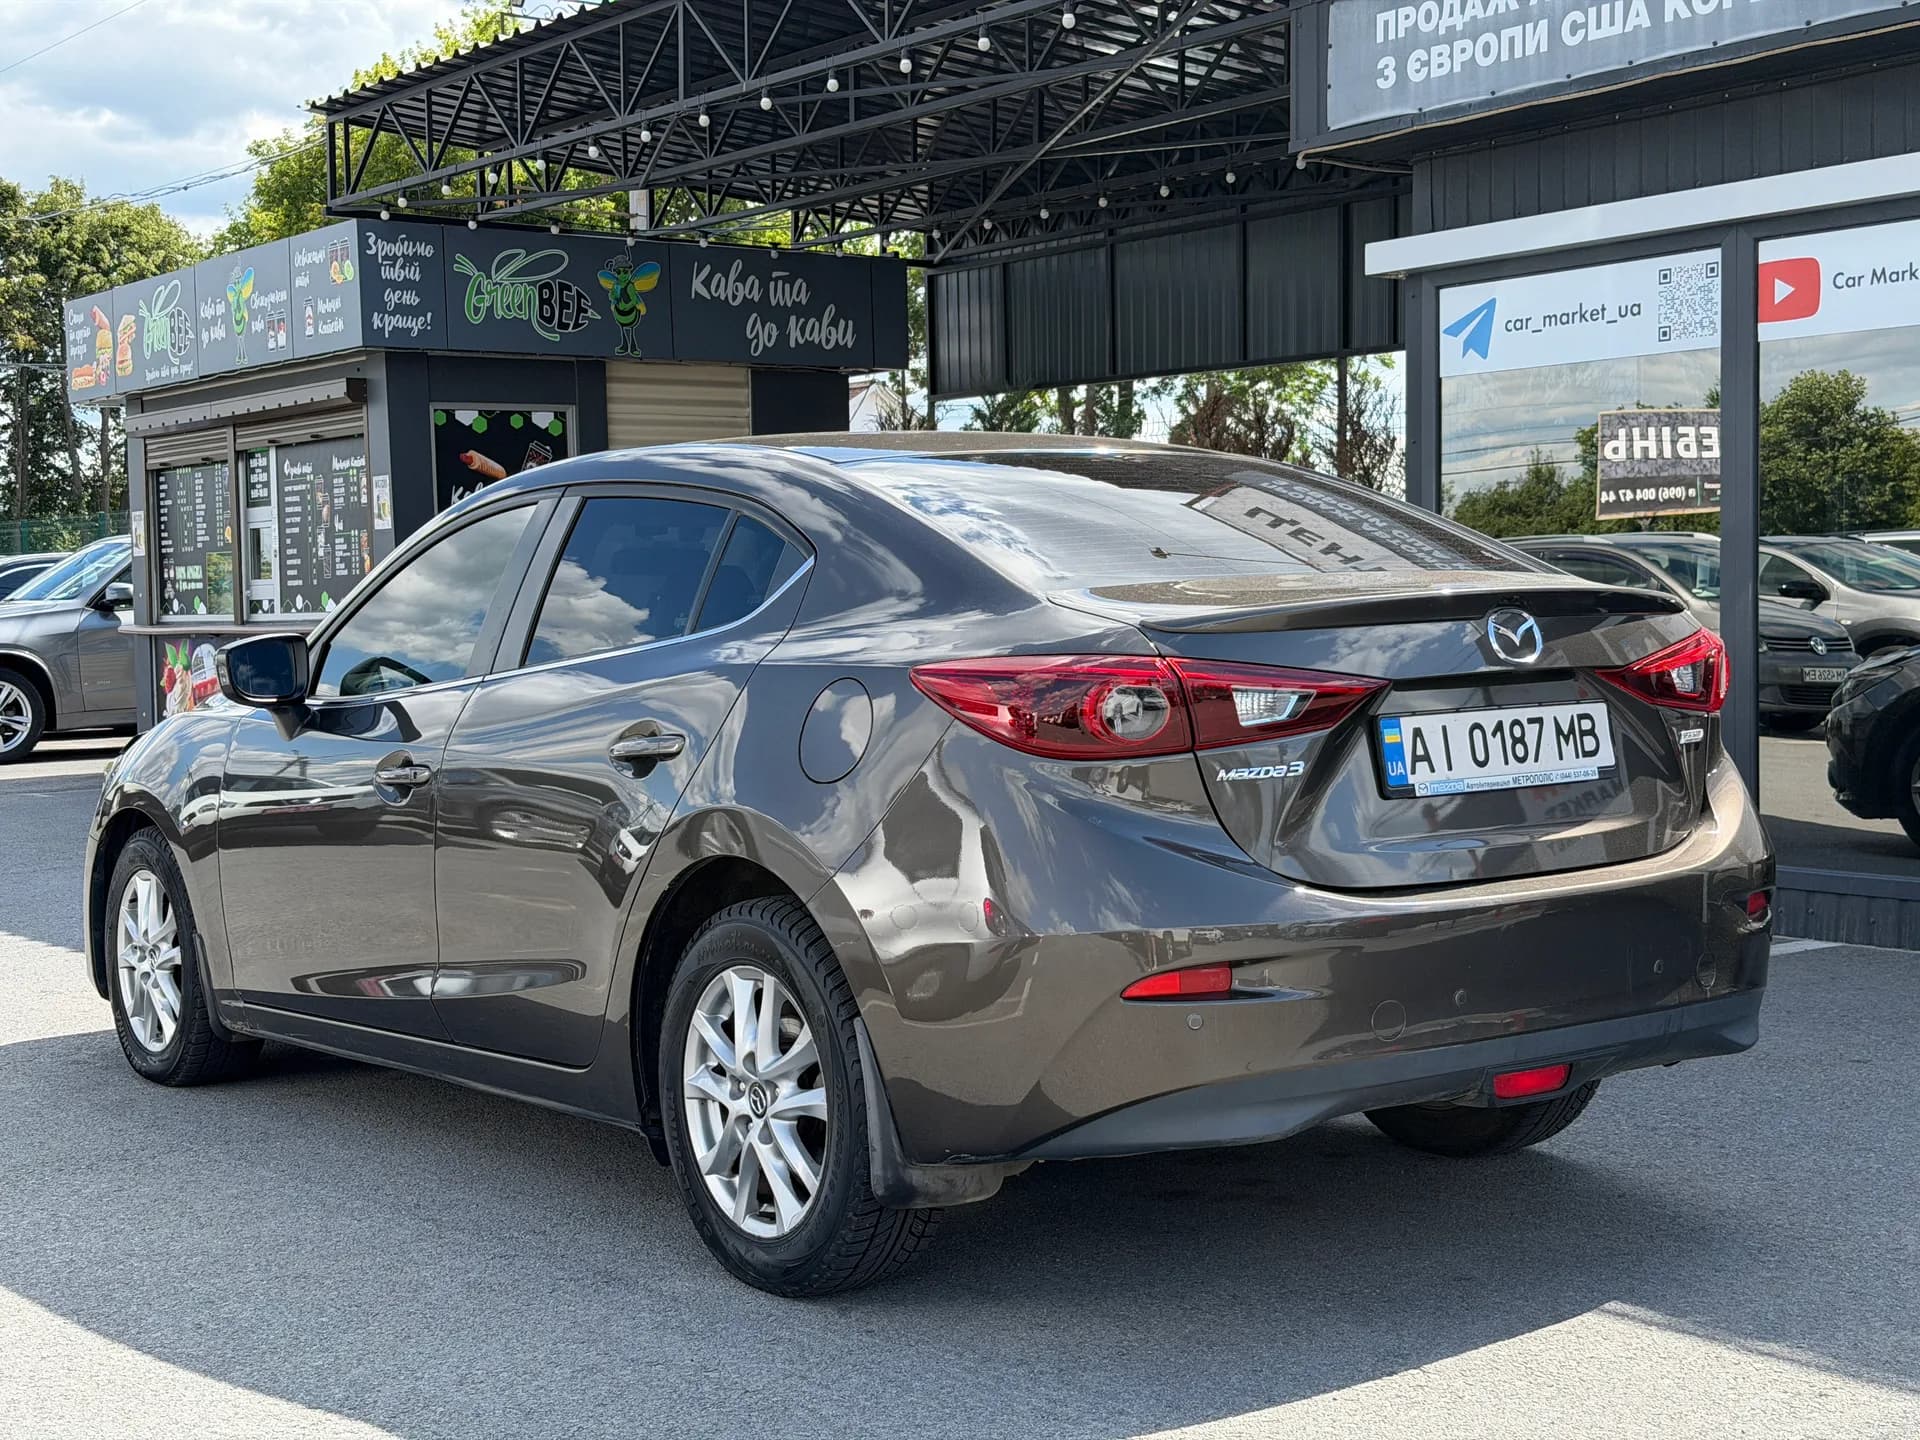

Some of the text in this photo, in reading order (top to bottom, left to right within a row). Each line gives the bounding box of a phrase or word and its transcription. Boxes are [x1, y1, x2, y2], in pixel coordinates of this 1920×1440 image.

[1376, 56, 1397, 89] З
[1407, 19, 1548, 82] ЄВРОПИ
[1561, 0, 1651, 47] США
[365, 232, 434, 263] Зробимо
[381, 257, 421, 282] твій
[691, 259, 811, 307] Кава та
[1833, 262, 1919, 289] Car Mark
[384, 288, 420, 311] день
[372, 312, 432, 338] краще!
[746, 304, 856, 356] до кави
[1505, 302, 1641, 333] car_market_ua
[1410, 712, 1600, 776] AI 0187 MB
[1388, 761, 1405, 777] UA
